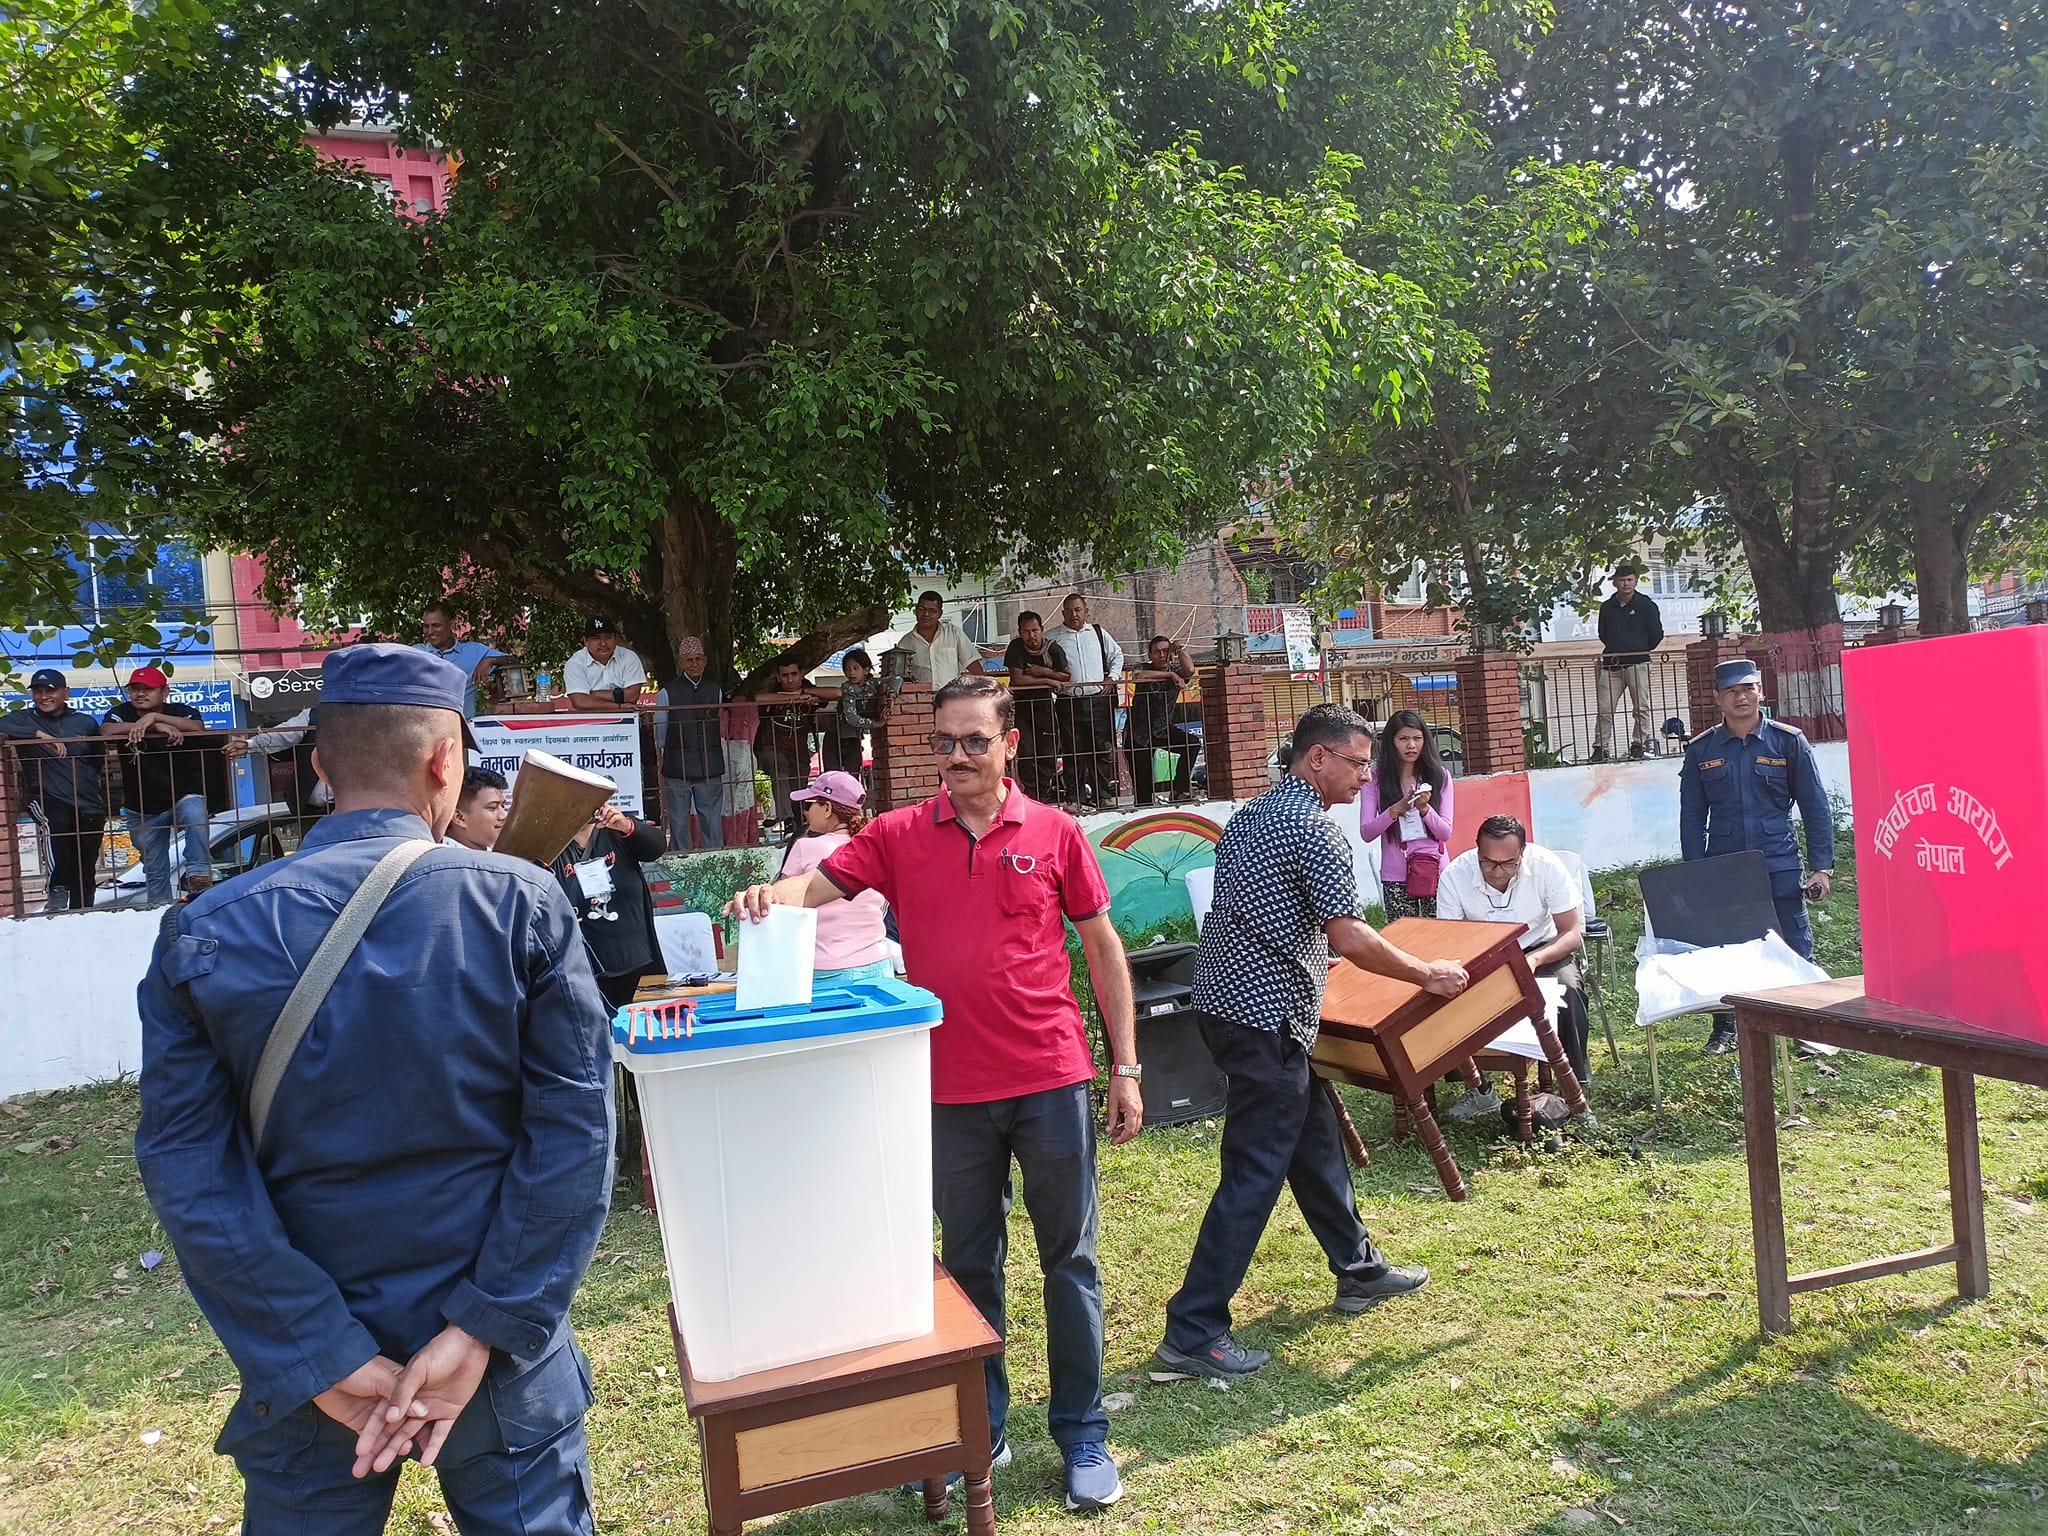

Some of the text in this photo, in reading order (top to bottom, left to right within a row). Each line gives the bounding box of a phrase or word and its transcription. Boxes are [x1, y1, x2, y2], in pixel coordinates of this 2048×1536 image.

[577, 749, 634, 770] कार्यक्रम
[1874, 783, 2014, 871] निर्वाचन आयोग
[1914, 837, 1966, 874] नेपाल
